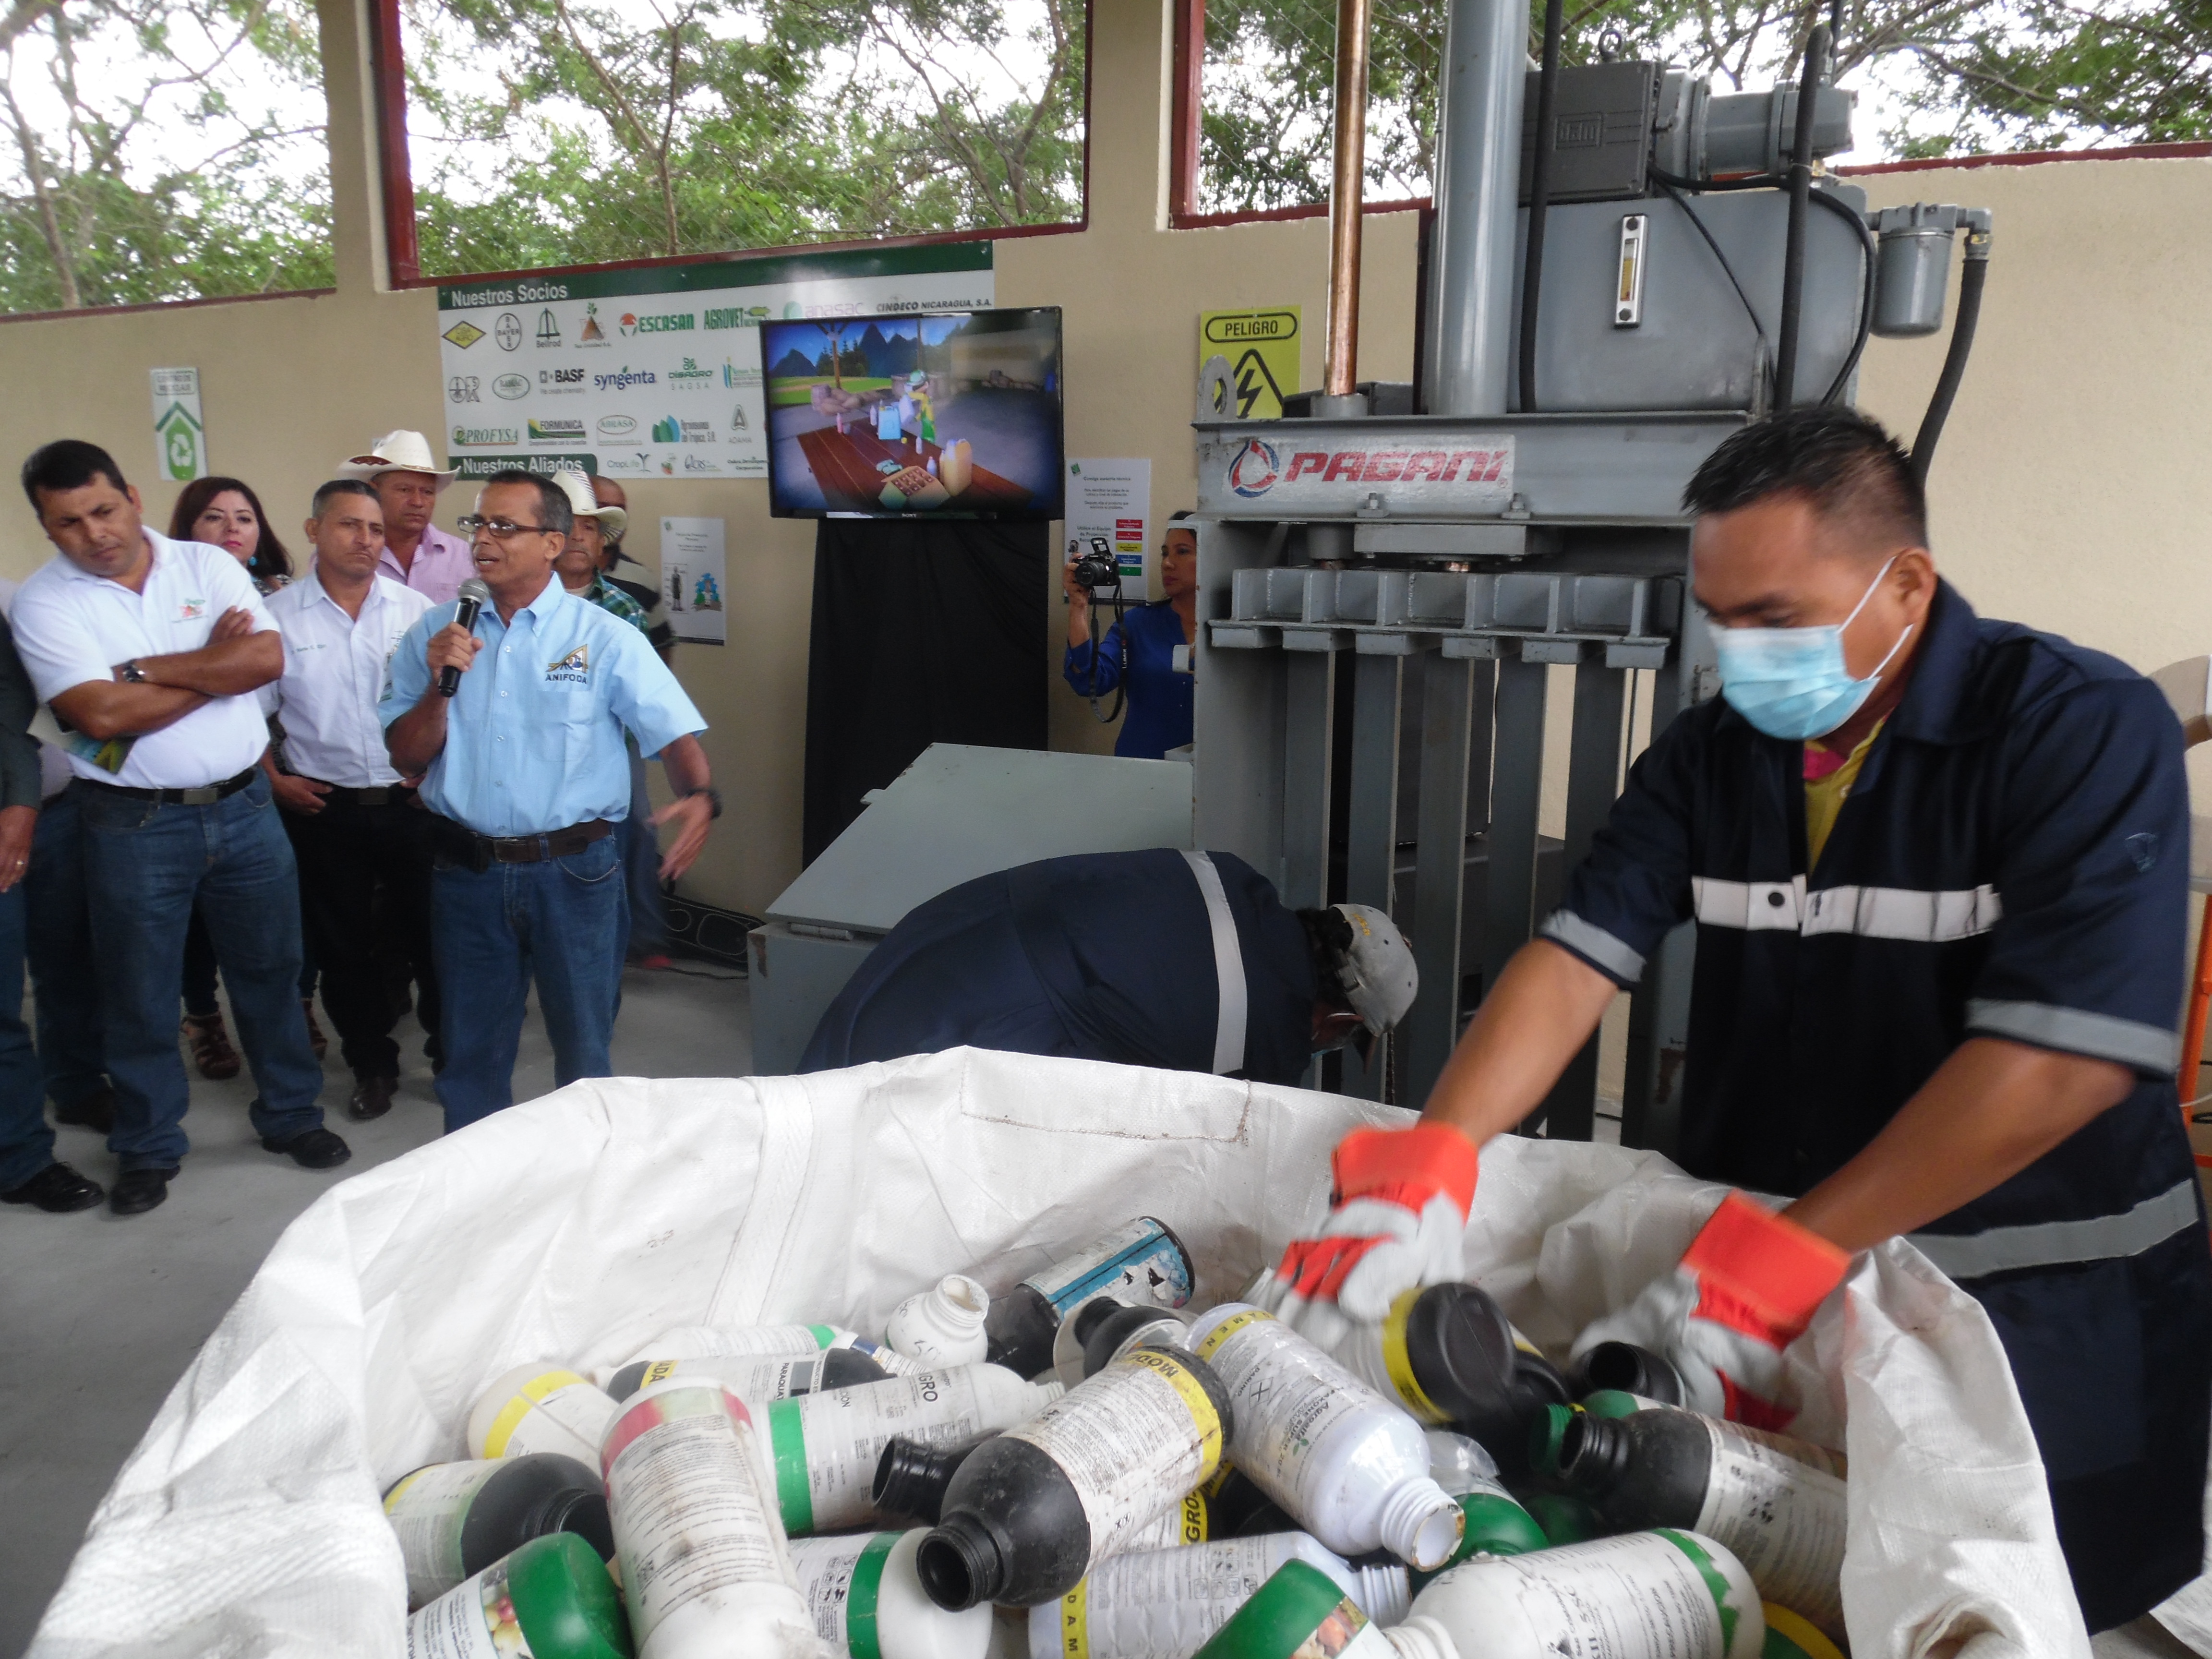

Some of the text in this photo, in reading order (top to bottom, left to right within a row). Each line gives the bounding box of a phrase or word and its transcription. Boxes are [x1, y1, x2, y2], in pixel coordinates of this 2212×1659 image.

[452, 282, 568, 307] Nuestros Socios
[805, 302, 864, 318] anasac
[876, 298, 992, 312] CINDECO NICARAGUA, S.A.
[639, 313, 694, 332] ESCASAN
[704, 307, 744, 330] AGROVET
[1225, 320, 1278, 337] PELIGRO
[554, 368, 584, 383] BASF
[594, 370, 656, 390] syngenta
[540, 420, 583, 430] FORMUNICA
[466, 428, 518, 443] PROFYSA
[529, 457, 583, 472] Aliados
[1283, 450, 1509, 482] PAGANI
[545, 673, 587, 684] ANIFODA
[918, 1374, 938, 1403] GRO
